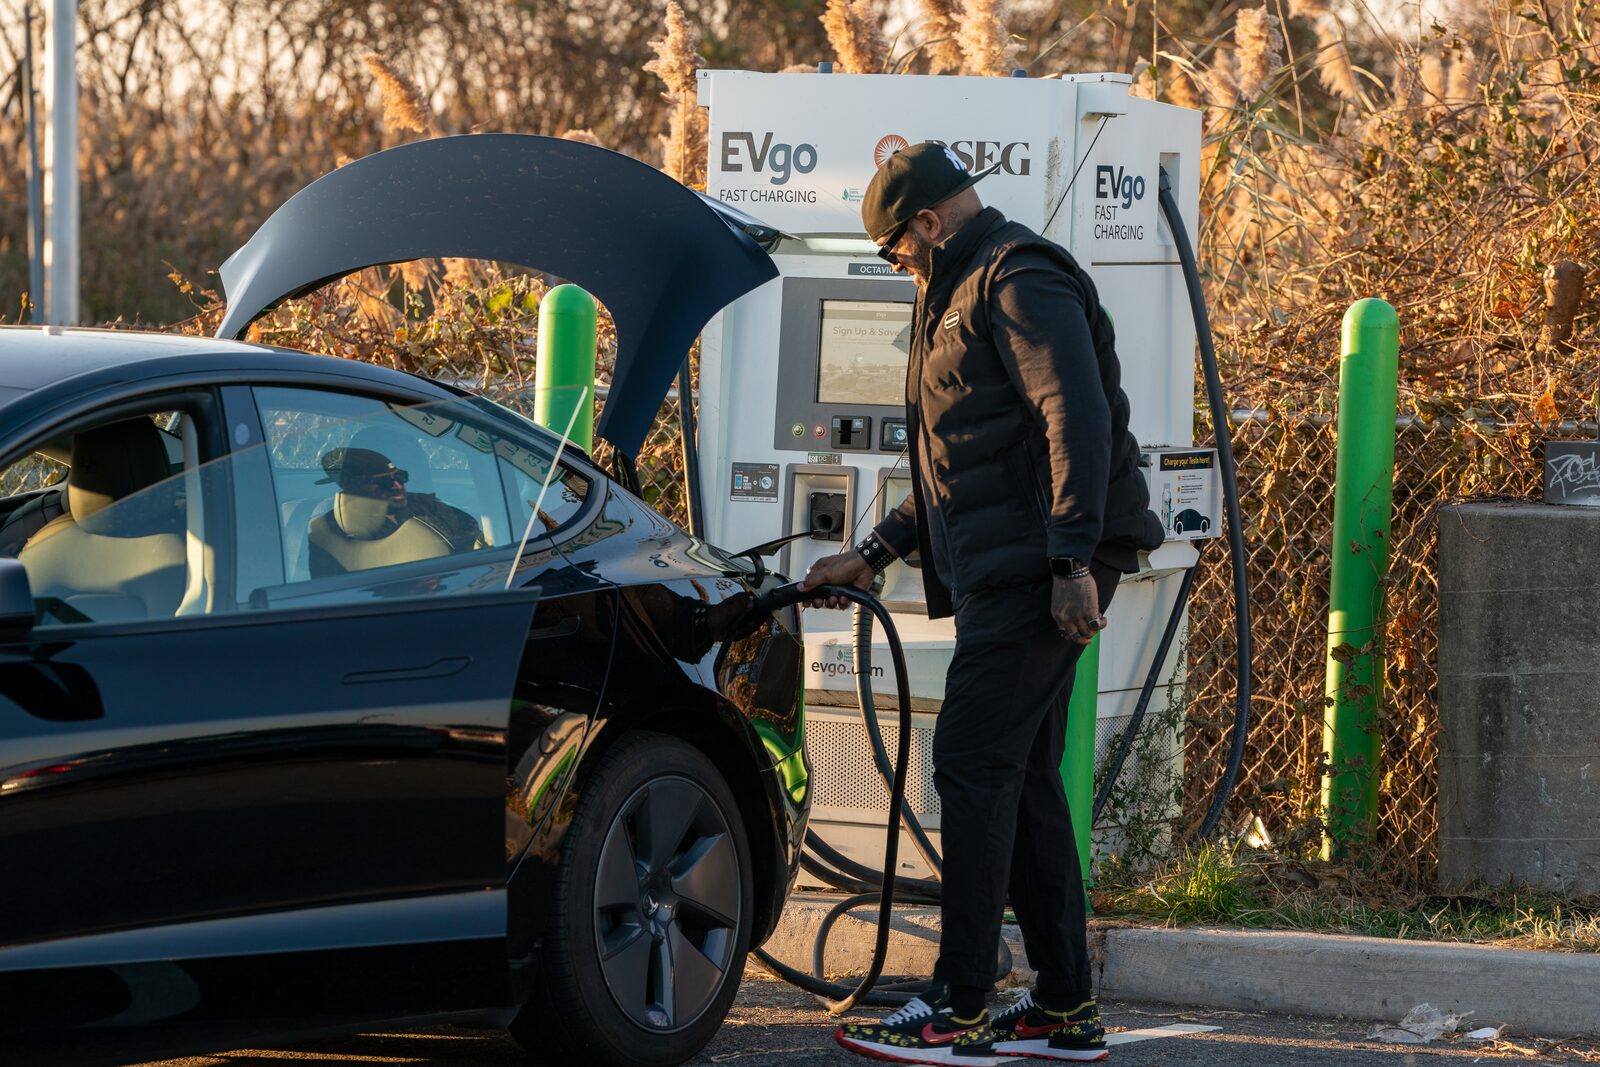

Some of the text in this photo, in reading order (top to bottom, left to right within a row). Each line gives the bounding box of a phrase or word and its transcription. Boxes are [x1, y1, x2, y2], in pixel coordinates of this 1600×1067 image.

[721, 131, 818, 185] EVgo
[925, 139, 1031, 176] SEG
[1095, 165, 1145, 210] EVgo
[720, 189, 817, 203] FAST CHARGING
[1094, 205, 1118, 220] FAST
[1094, 224, 1144, 240] CHARGING
[860, 265, 899, 274] OCTAVIU
[833, 327, 852, 336] Sign
[854, 327, 867, 337] Up
[869, 327, 876, 336] &
[818, 453, 828, 462] DC
[1164, 457, 1178, 467] Charge
[1179, 457, 1188, 467] your
[811, 662, 883, 677] evgo.m
